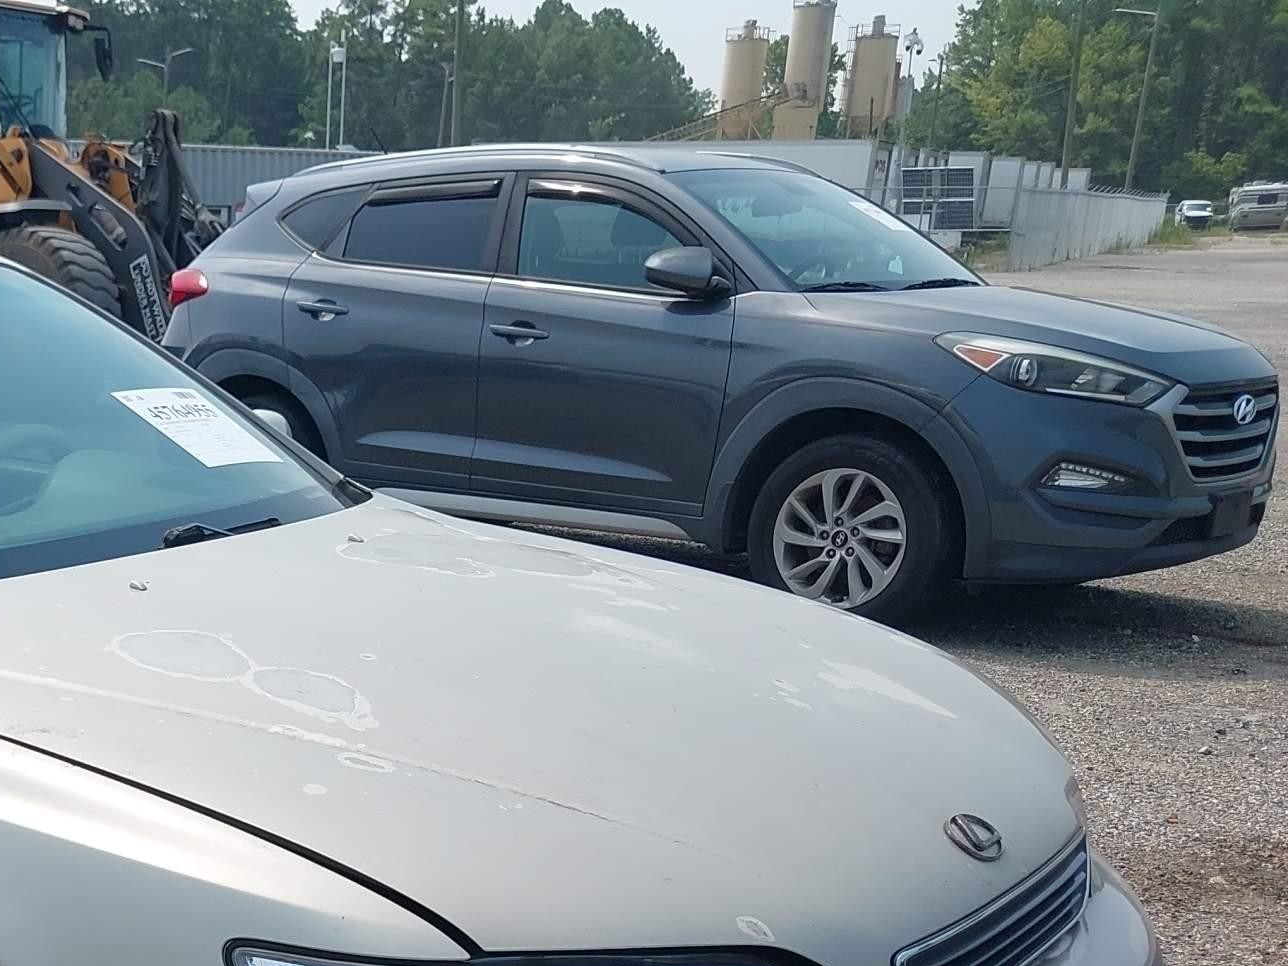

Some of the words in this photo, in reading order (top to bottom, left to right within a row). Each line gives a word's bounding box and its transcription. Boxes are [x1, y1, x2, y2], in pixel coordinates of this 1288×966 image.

[134, 269, 149, 308] UNDER
[144, 277, 157, 302] NOT
[152, 305, 167, 336] WALK
[147, 403, 218, 420] 45764955
